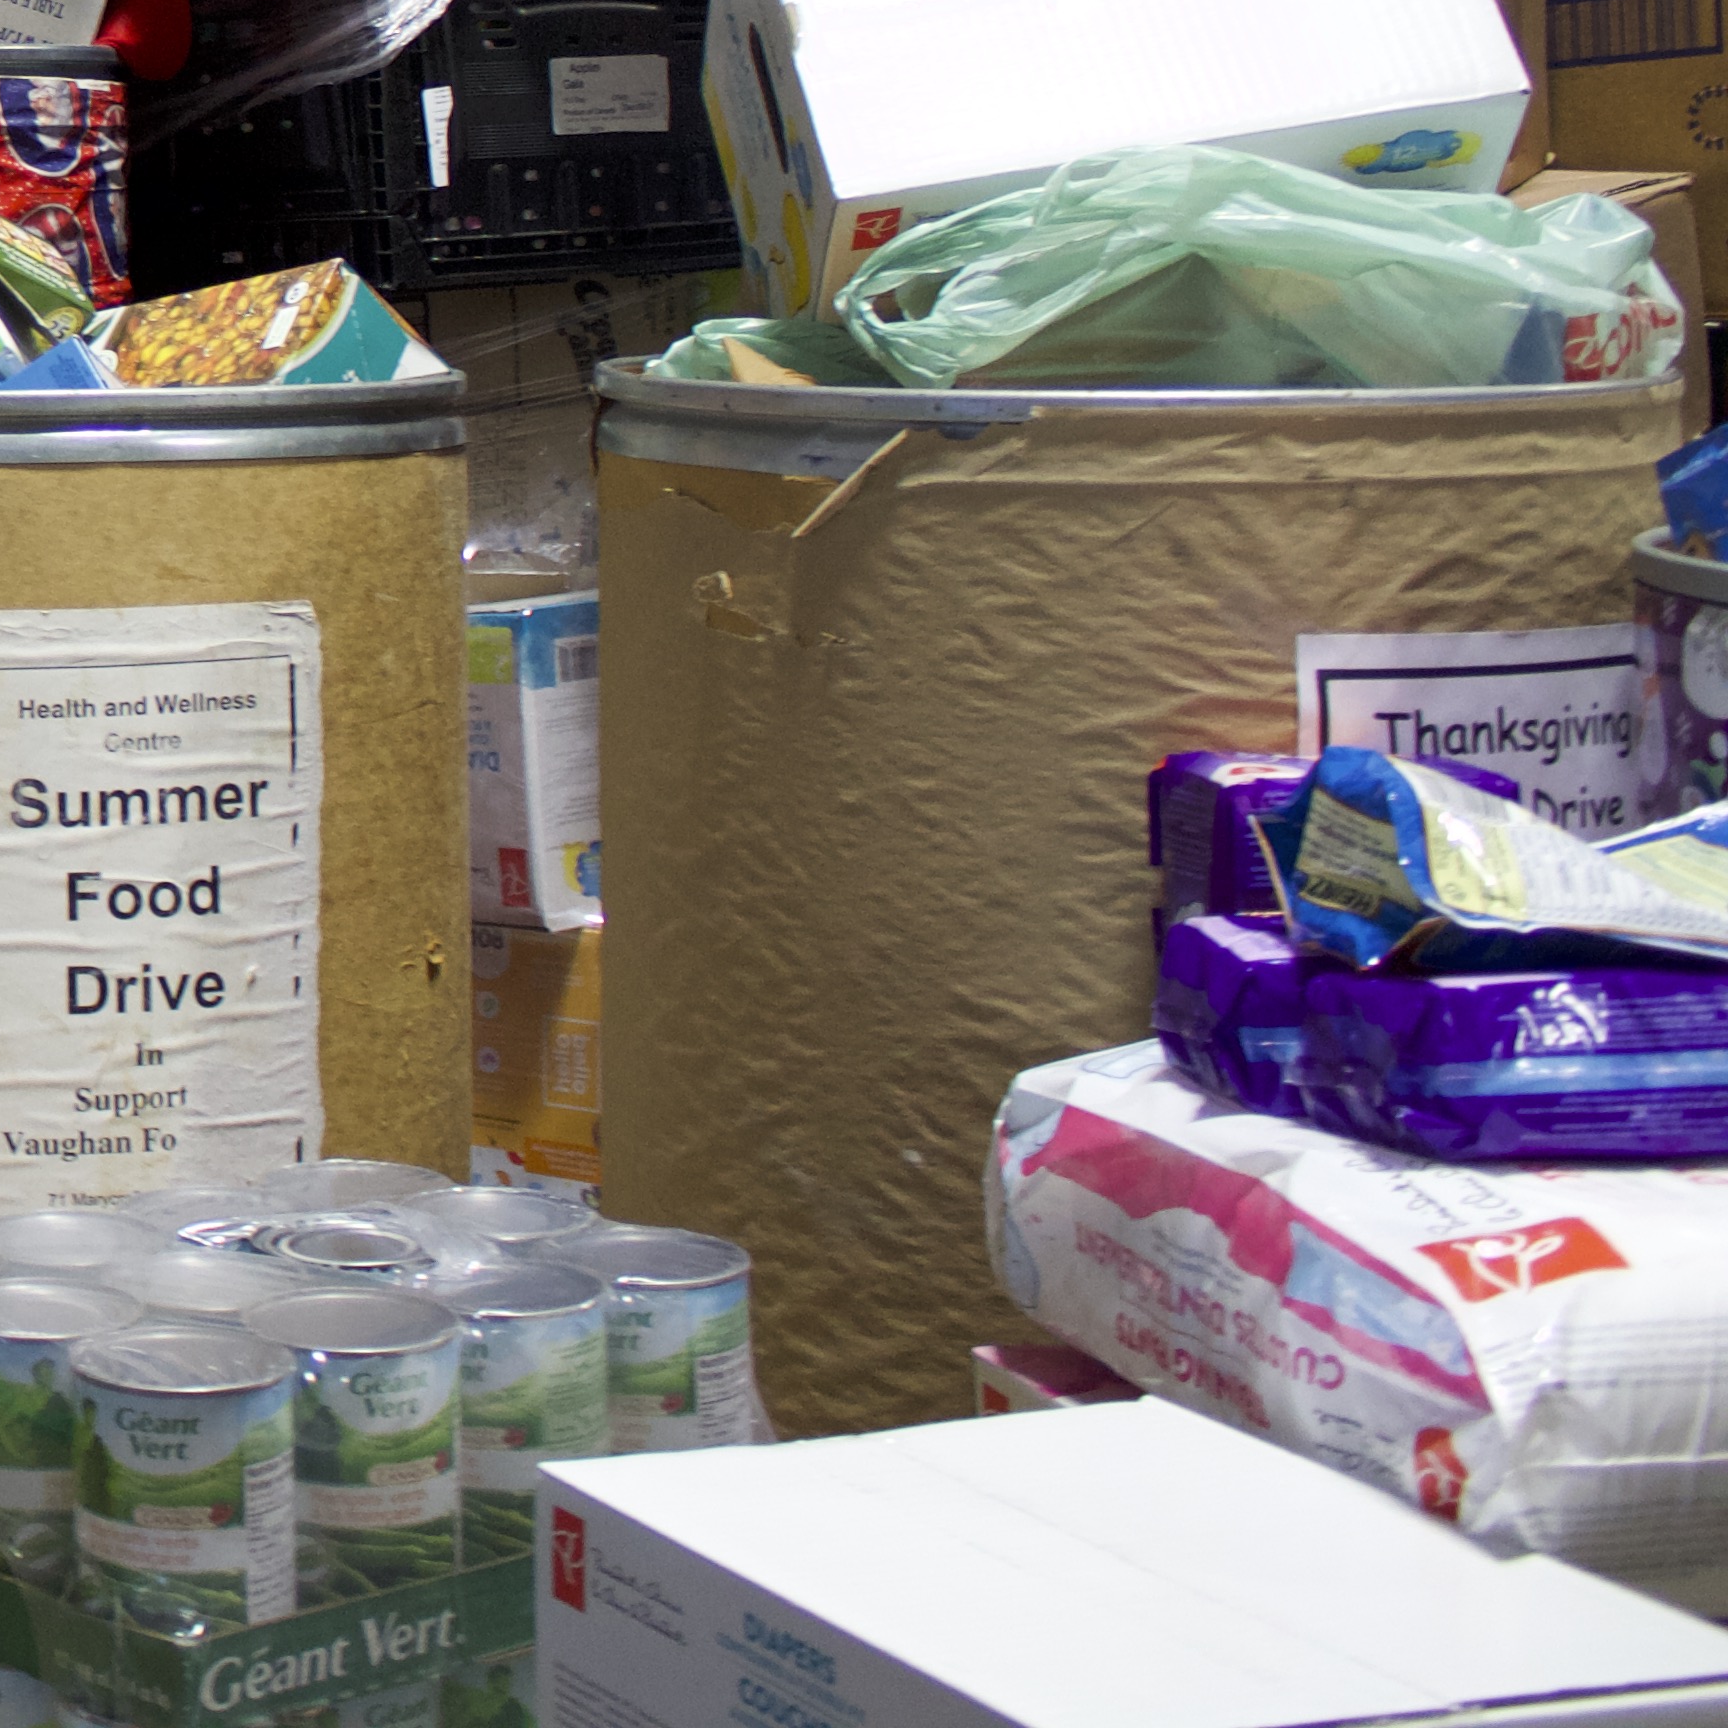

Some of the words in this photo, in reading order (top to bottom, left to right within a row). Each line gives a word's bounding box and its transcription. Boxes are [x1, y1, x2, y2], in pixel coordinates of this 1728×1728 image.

[18, 697, 97, 722] Health
[104, 694, 149, 718] and
[155, 688, 258, 716] Wellness
[104, 730, 182, 755] Centre
[1374, 702, 1634, 765] Thanksgiving
[9, 777, 270, 830] Summer
[66, 866, 222, 922] Food
[66, 963, 227, 1016] Drive
[73, 1083, 189, 1116] Support
[3, 1129, 134, 1159] Vaughan
[348, 1370, 430, 1401] Géant
[114, 1403, 201, 1438] Géant
[362, 1395, 422, 1420] Vert
[128, 1432, 190, 1462] Vert
[199, 1646, 350, 1714] Géant
